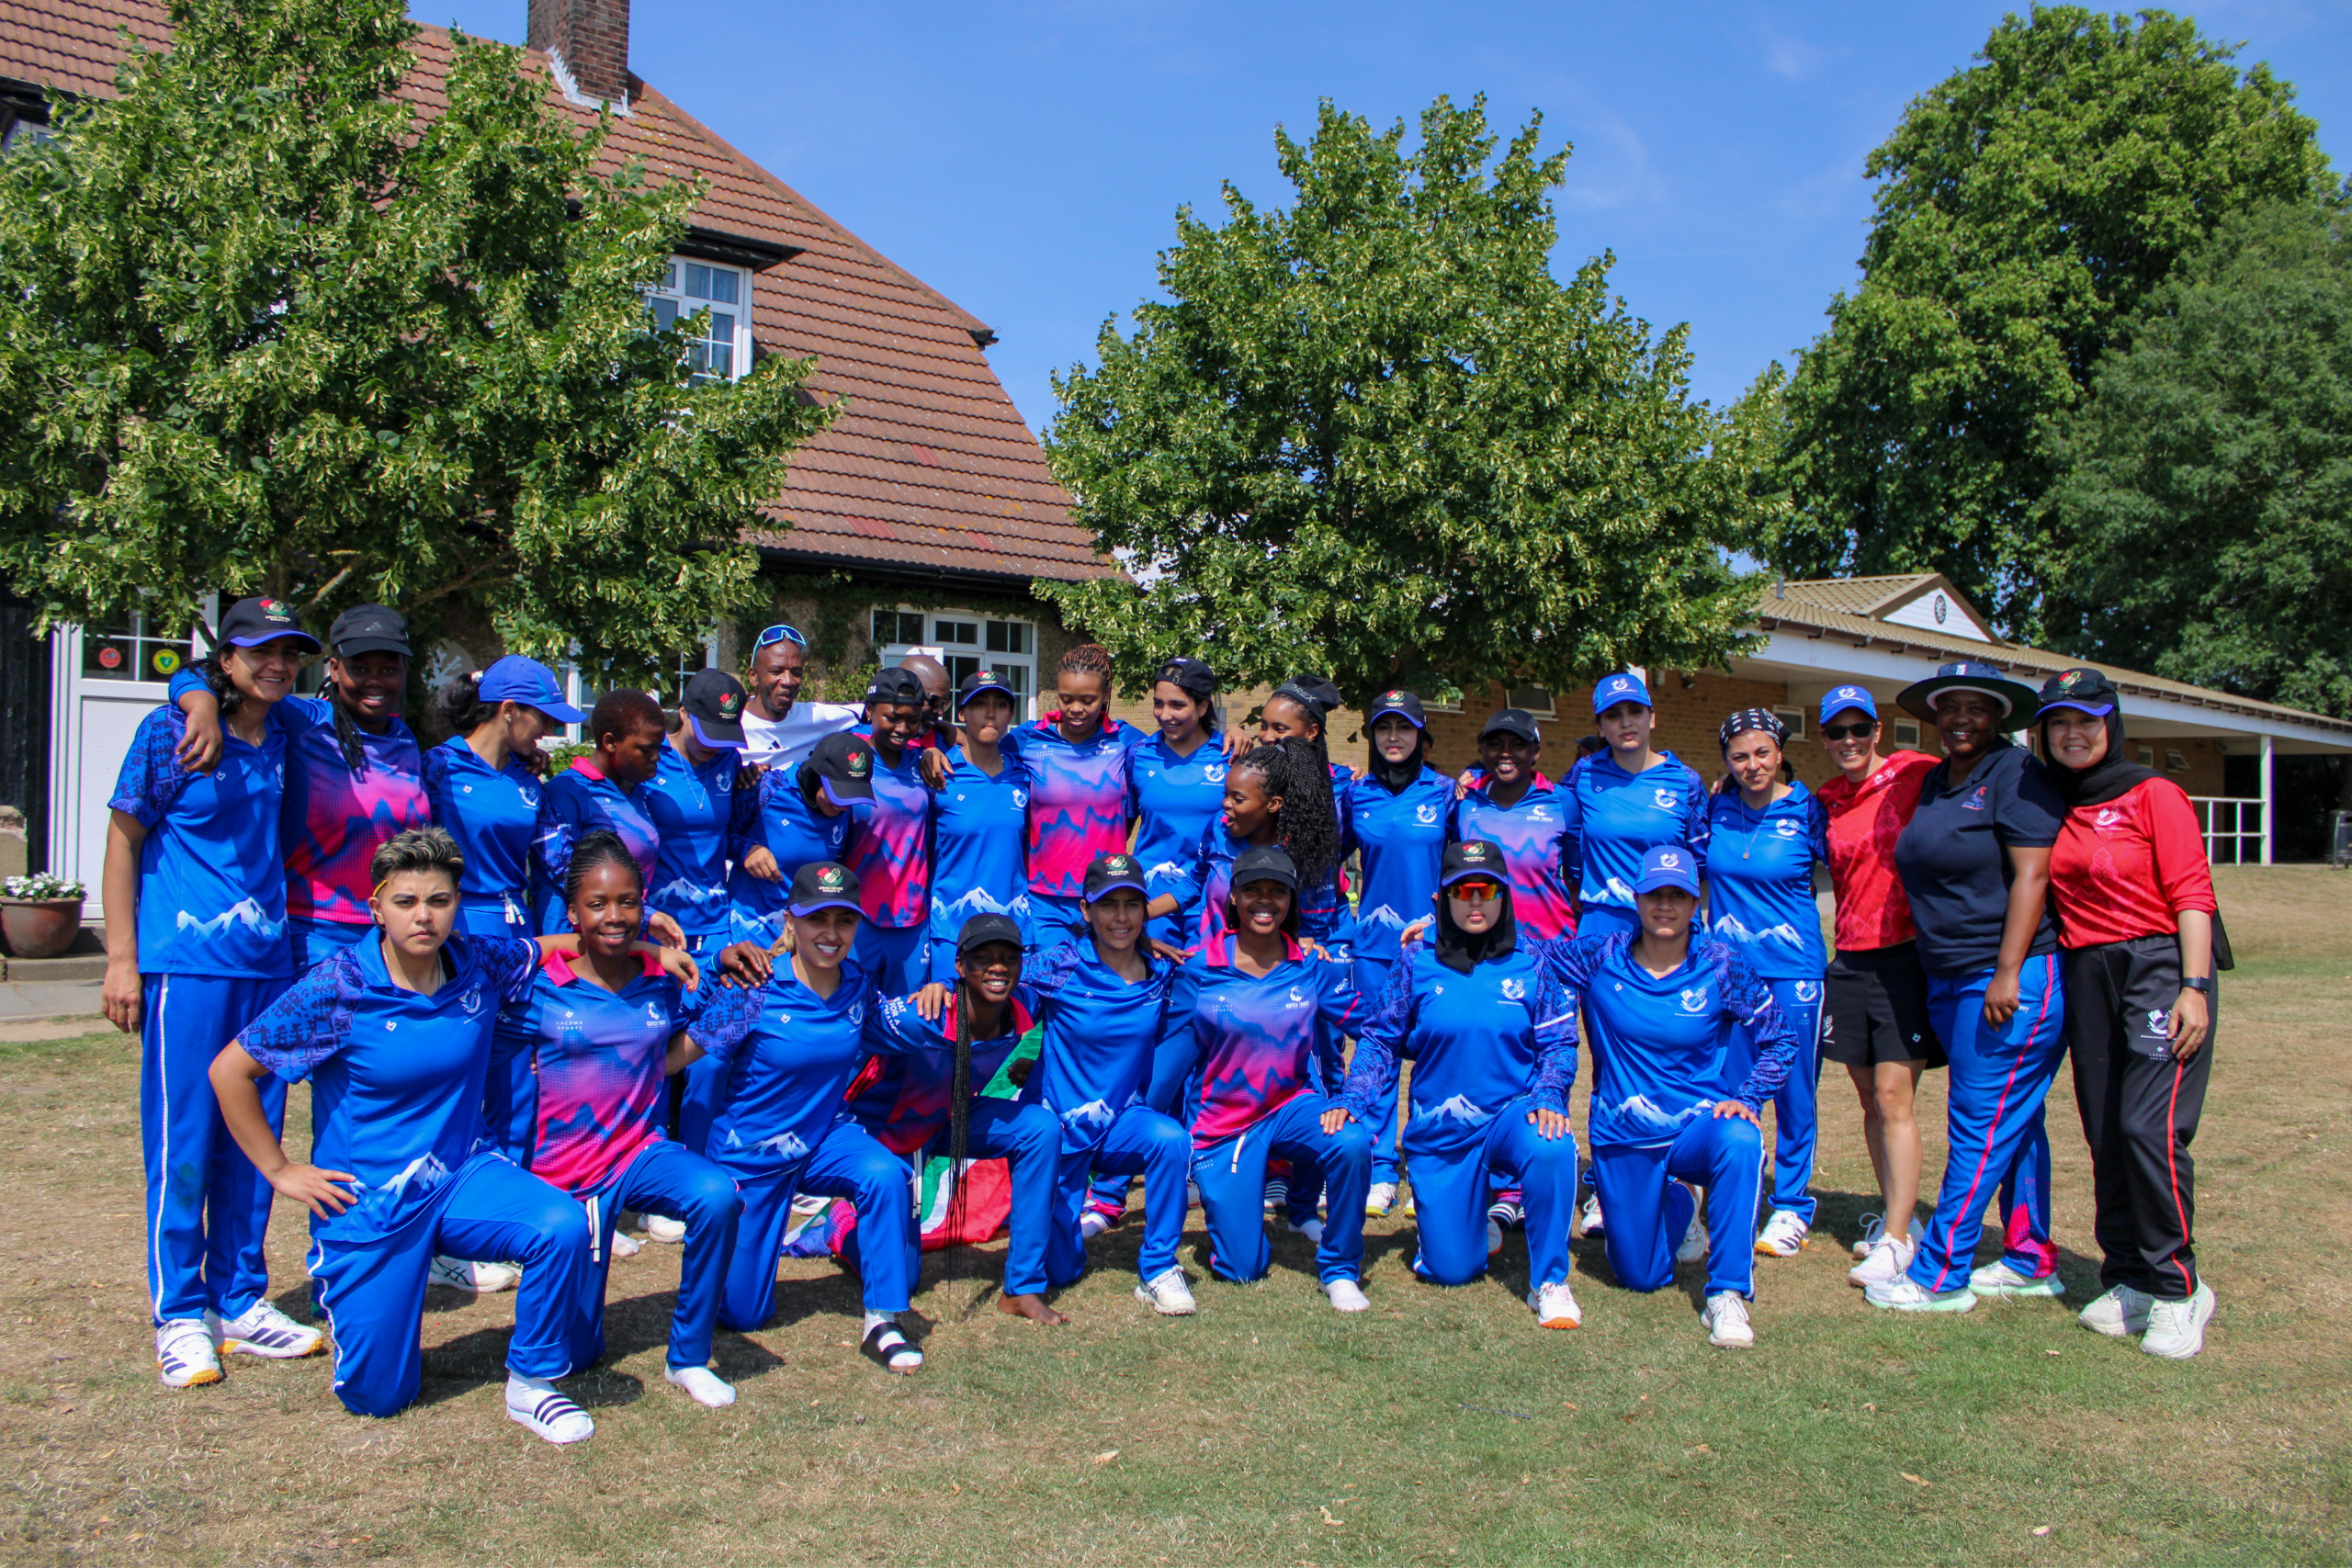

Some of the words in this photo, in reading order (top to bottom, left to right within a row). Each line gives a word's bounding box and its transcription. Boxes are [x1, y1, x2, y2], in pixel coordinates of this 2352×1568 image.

[888, 1002, 899, 1018] FOR
[897, 999, 907, 1013] BAT
[893, 1018, 901, 1026] A
